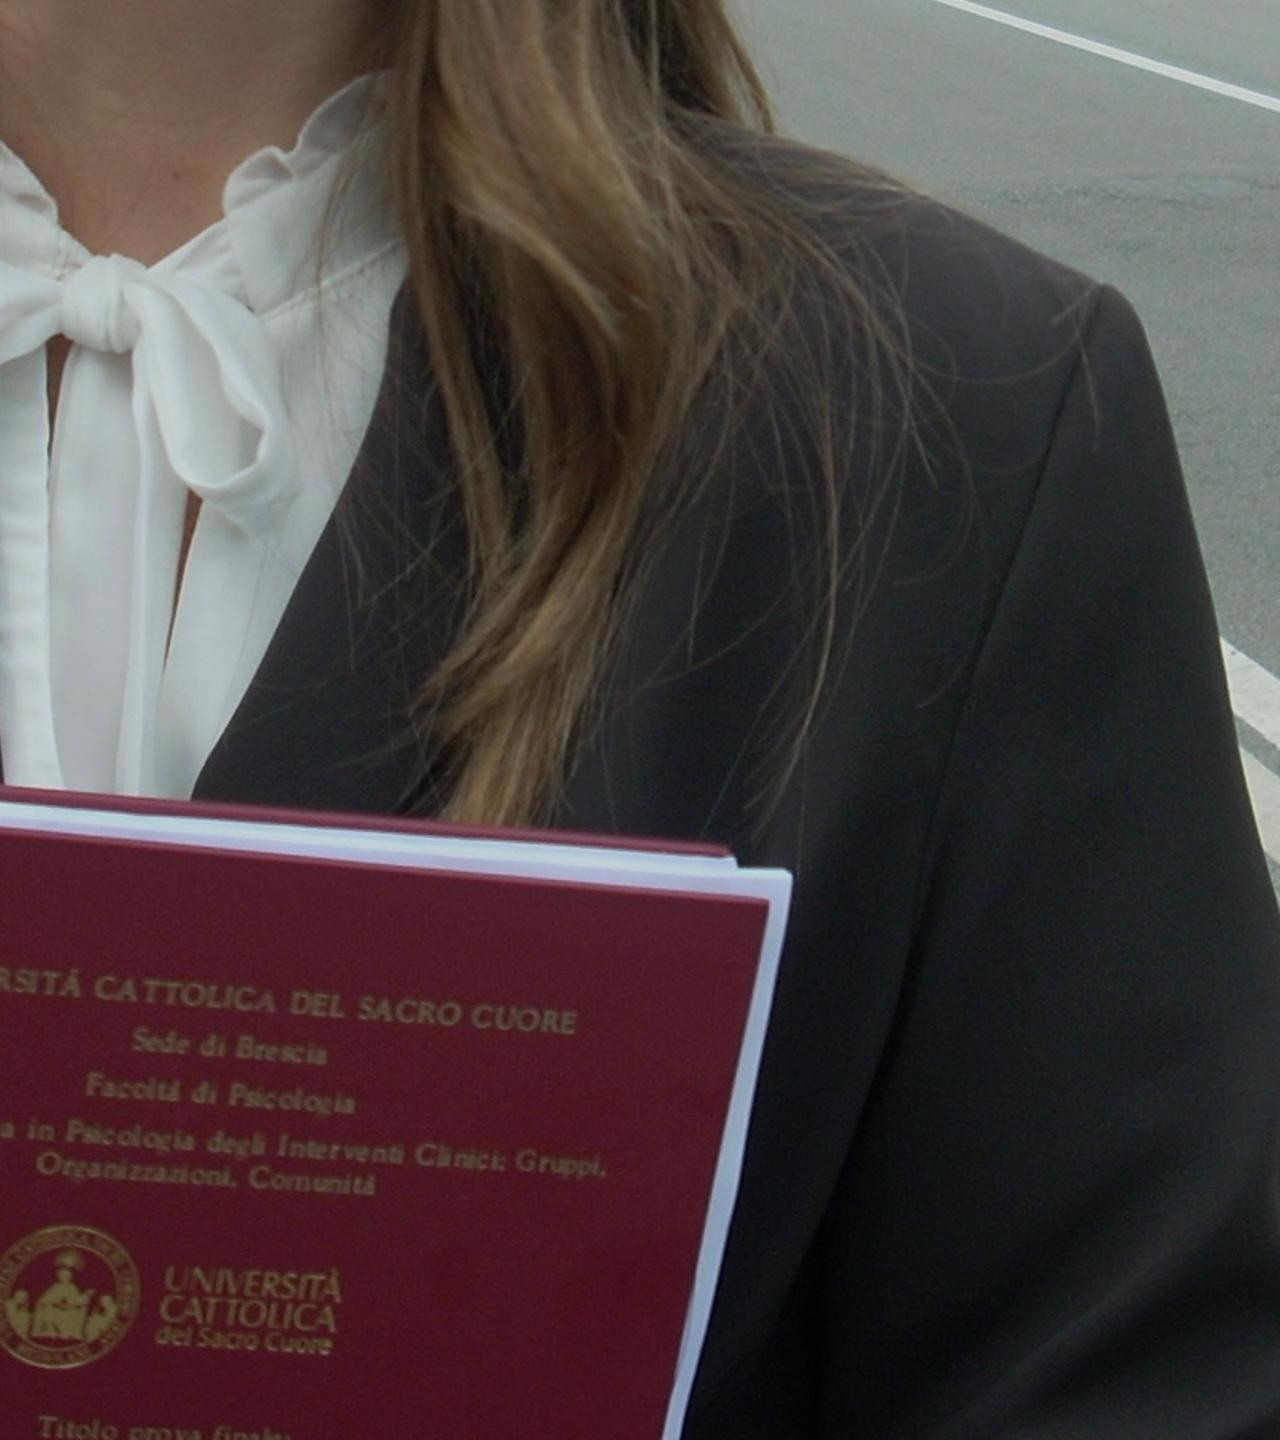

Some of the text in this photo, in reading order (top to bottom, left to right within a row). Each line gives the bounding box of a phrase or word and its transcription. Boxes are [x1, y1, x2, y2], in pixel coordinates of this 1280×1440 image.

[94, 974, 278, 1013] CATTOLICA
[288, 990, 345, 1019] DEL
[356, 994, 463, 1026] SACRO
[470, 1004, 578, 1036] CUORE
[130, 1026, 329, 1066] Sede di Brescia
[190, 1080, 218, 1105] di
[228, 1082, 358, 1116] Psicologia
[26, 1118, 56, 1141] in
[65, 1119, 196, 1152] Psicologia
[205, 1130, 268, 1159] degli
[276, 1132, 406, 1164] Interventi
[159, 1294, 337, 1333] CATTOLICA
[154, 1324, 334, 1356] del Sacro Cuore
[38, 1415, 119, 1440] Titolo
